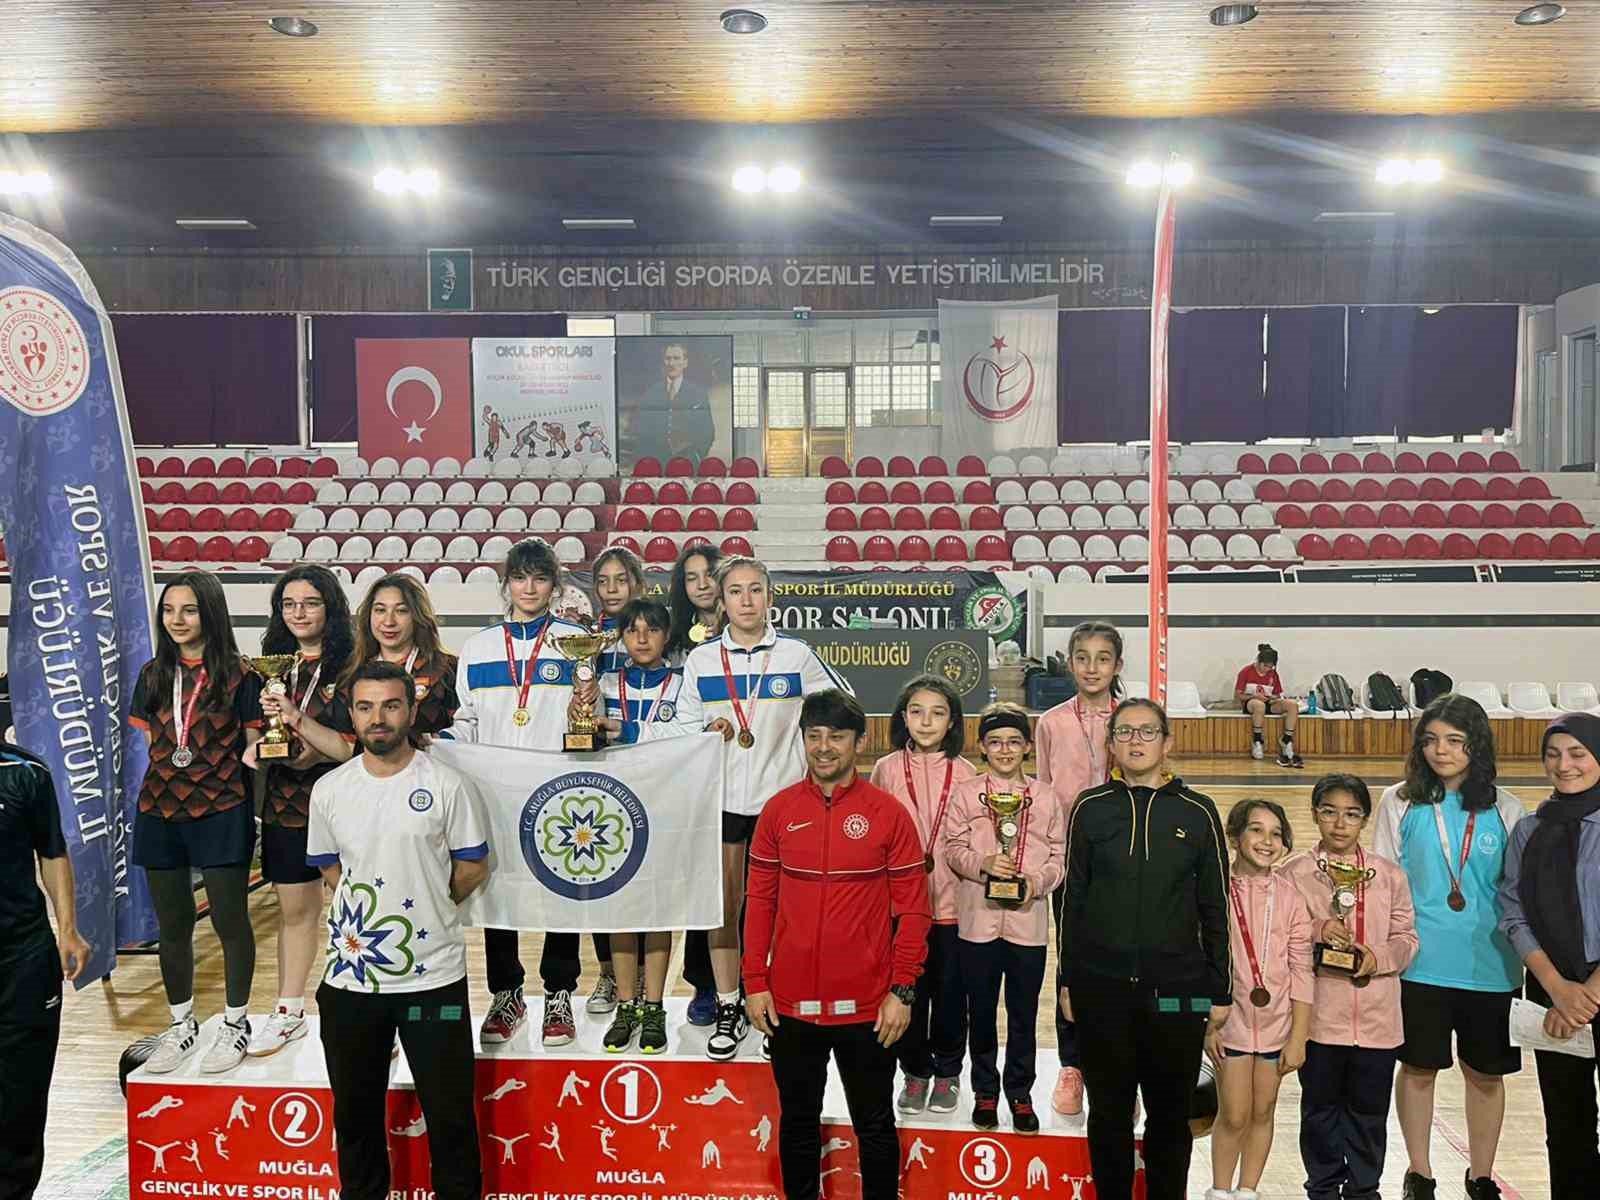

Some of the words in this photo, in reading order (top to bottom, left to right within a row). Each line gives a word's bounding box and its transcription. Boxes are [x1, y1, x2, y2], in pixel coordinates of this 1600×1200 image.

[486, 262, 549, 287] TÜRK
[558, 261, 665, 291] GENÇLİĞİ
[675, 265, 773, 287] SPORDA
[783, 260, 875, 285] ÖZENLE
[888, 258, 1105, 288] YETİŞTİRİLMELİDİR
[774, 583, 819, 596] SPOR
[823, 581, 841, 596] İL
[844, 580, 955, 596] MÜDÜRLÜĞÜ
[766, 606, 824, 630] POR
[816, 641, 911, 666] MÜDÜRLÜĞÜ
[617, 1070, 638, 1117] 1
[284, 1100, 306, 1139] 2
[259, 1160, 333, 1176] MUĞLA
[974, 1144, 996, 1181] 3
[596, 1169, 666, 1184] MUĞLA
[141, 1180, 221, 1198] GENÇLİK
[225, 1185, 249, 1197] VE
[253, 1186, 303, 1199] SPOR
[308, 1184, 323, 1200] İL
